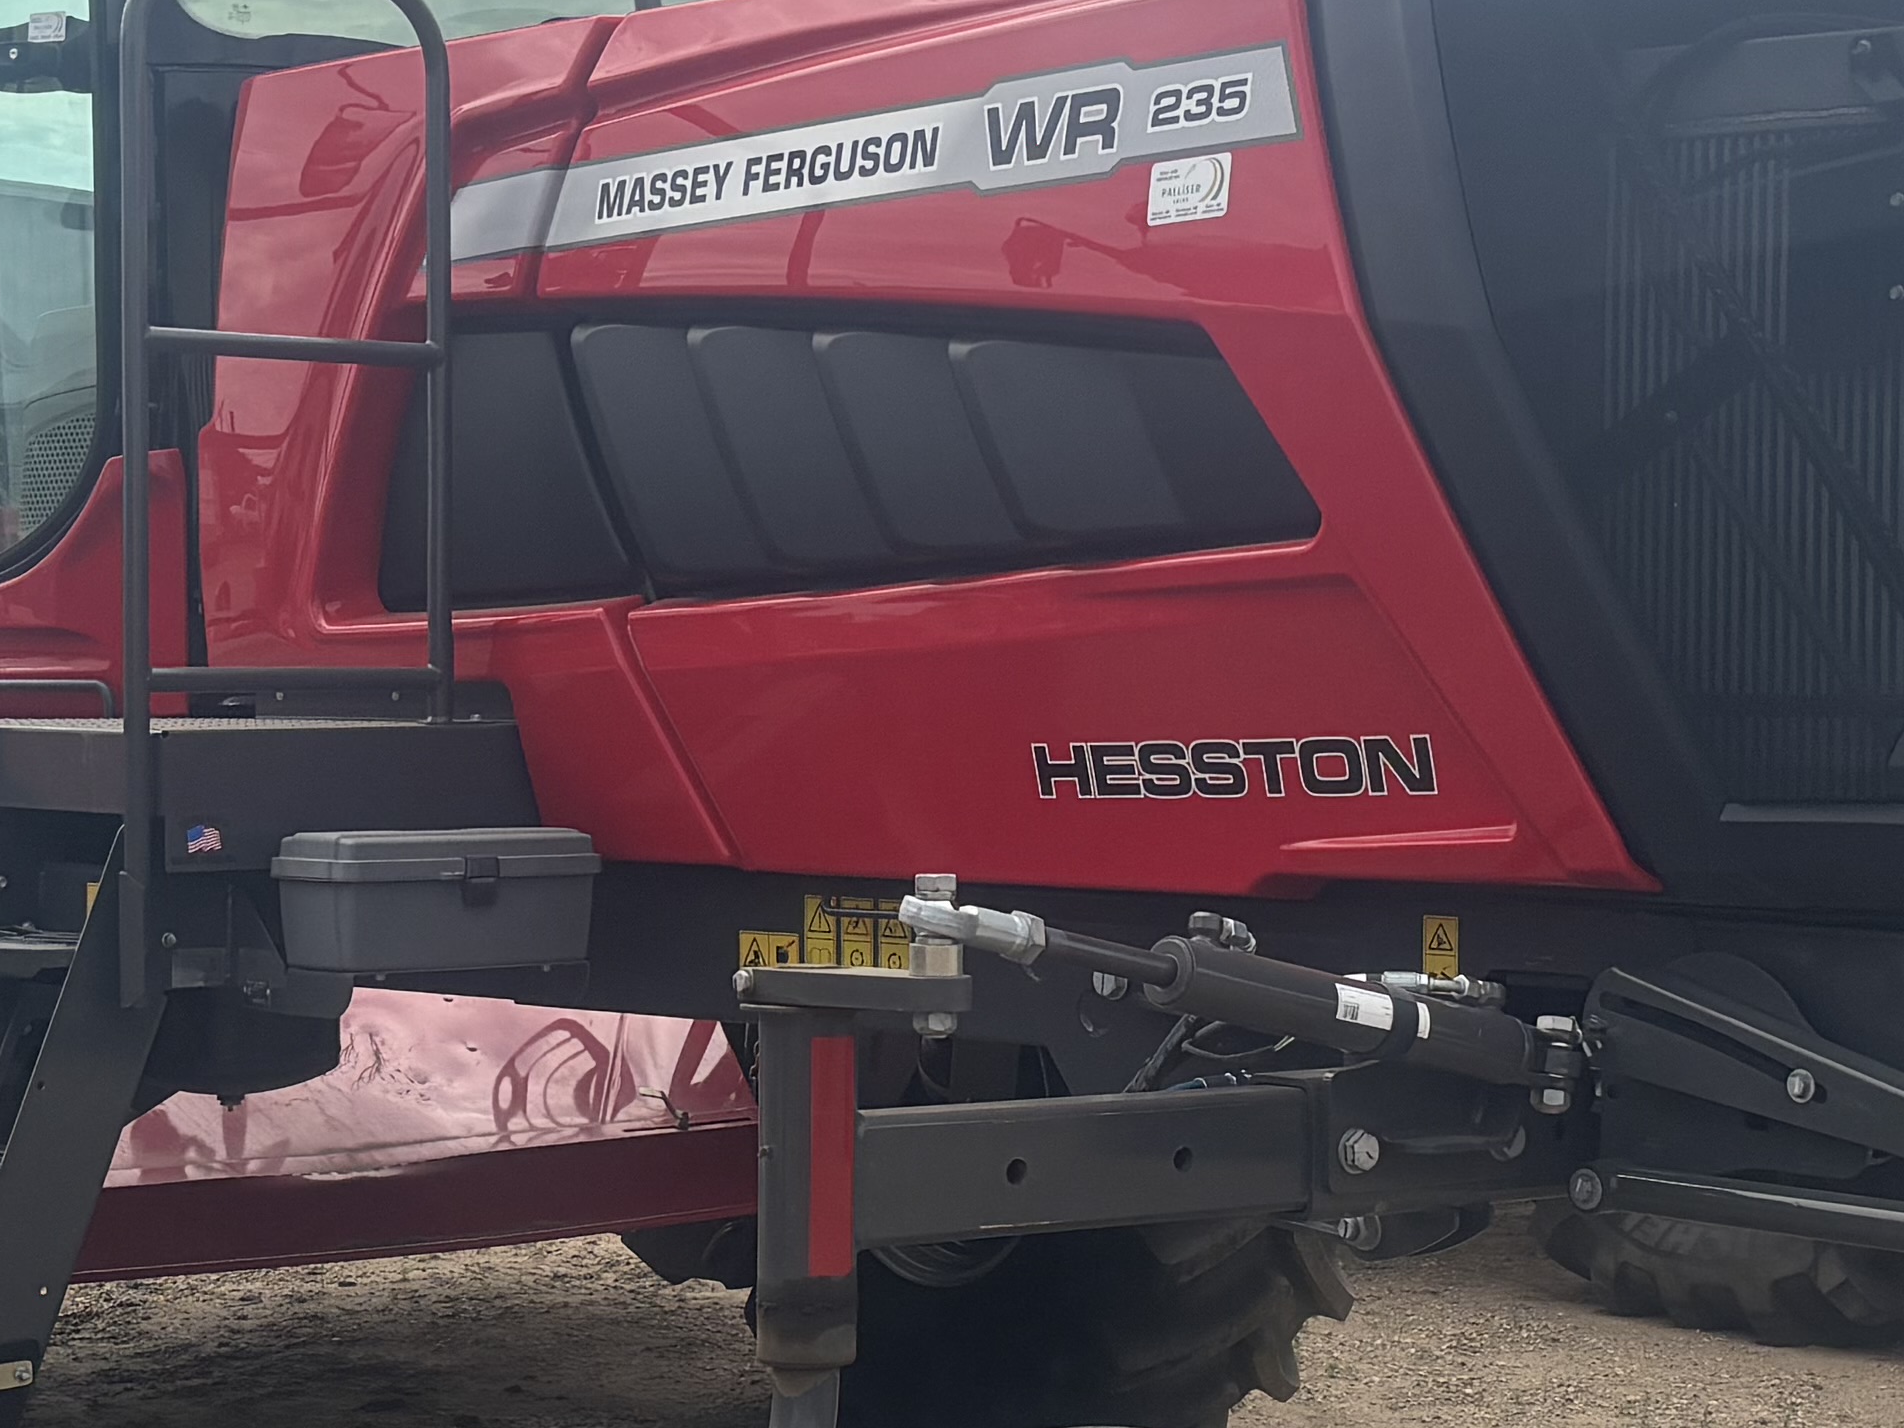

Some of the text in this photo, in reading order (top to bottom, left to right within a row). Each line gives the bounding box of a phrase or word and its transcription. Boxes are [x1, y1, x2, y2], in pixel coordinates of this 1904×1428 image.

[596, 76, 1250, 221] MASSEY FERGUSON WR 235
[1031, 734, 1438, 799] HESSTON
